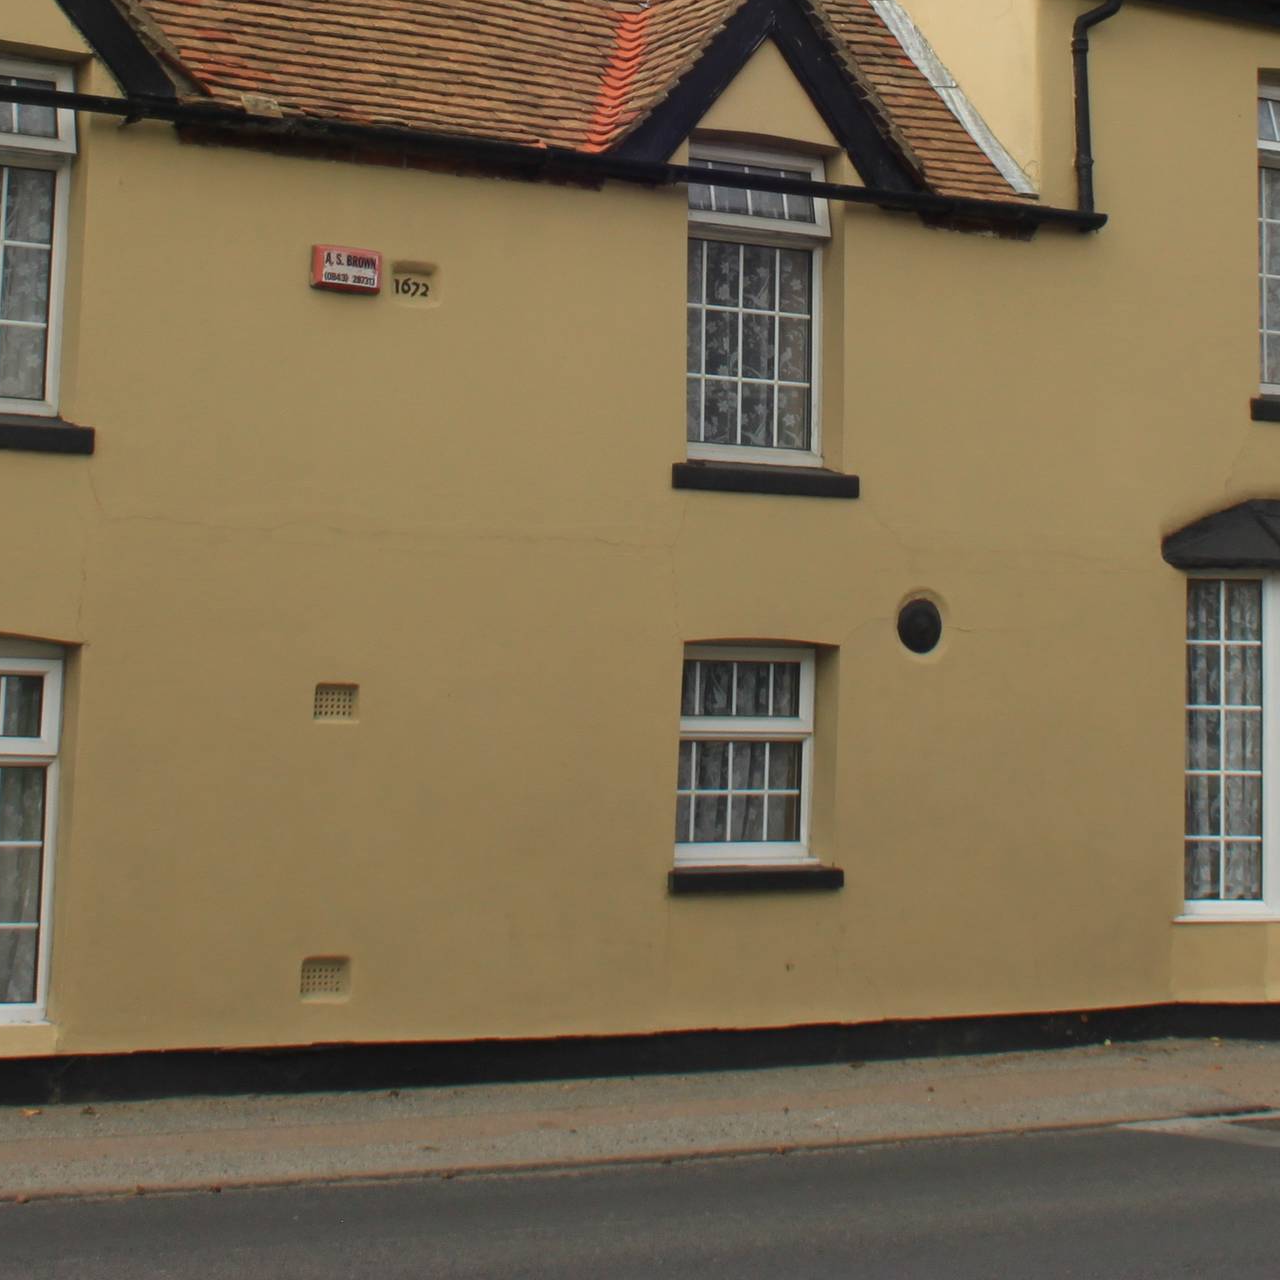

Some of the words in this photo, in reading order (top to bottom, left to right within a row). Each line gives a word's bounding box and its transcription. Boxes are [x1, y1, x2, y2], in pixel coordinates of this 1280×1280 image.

[336, 253, 345, 266] S.
[346, 255, 376, 270] BROWN
[394, 278, 430, 297] 1672
